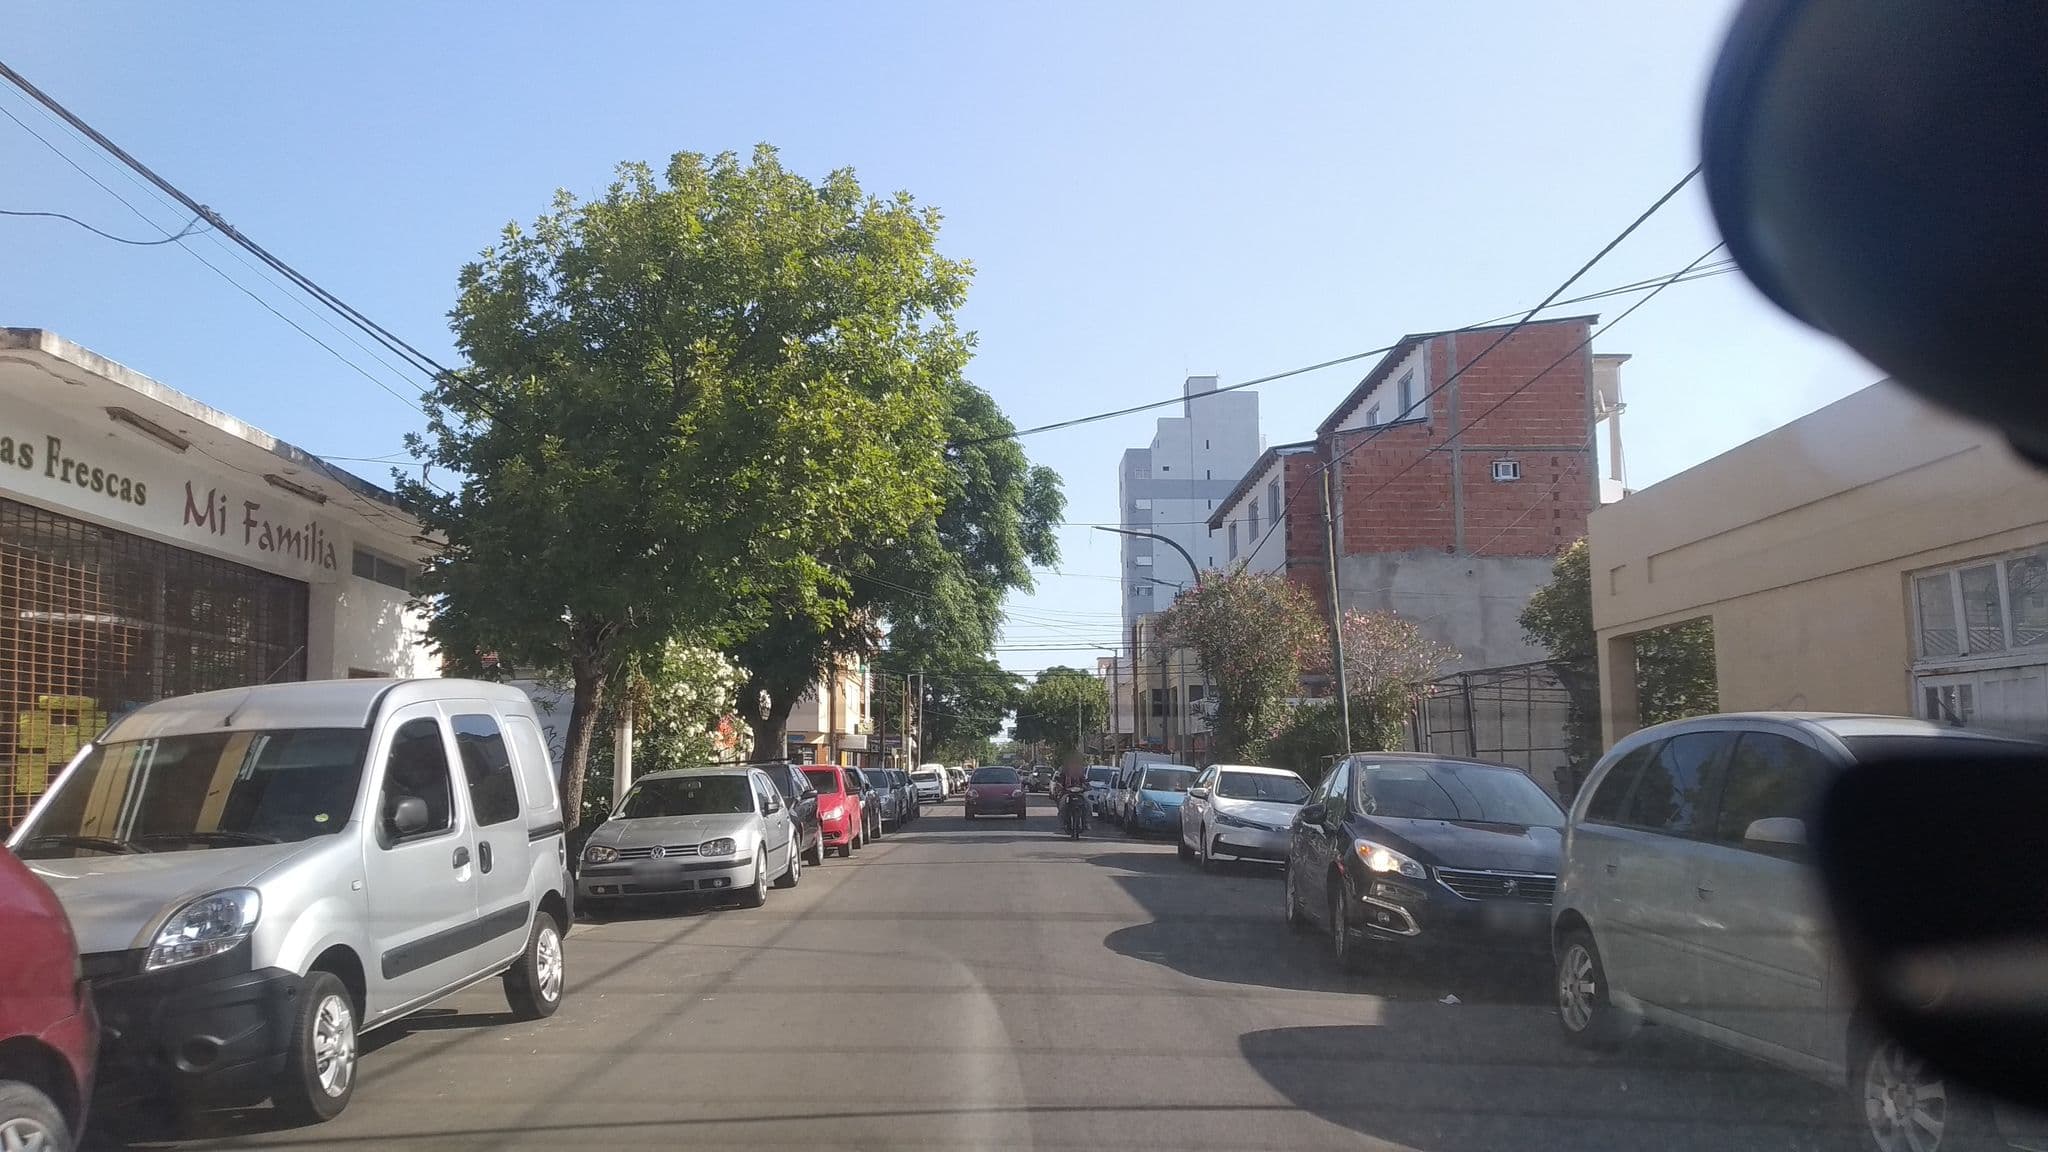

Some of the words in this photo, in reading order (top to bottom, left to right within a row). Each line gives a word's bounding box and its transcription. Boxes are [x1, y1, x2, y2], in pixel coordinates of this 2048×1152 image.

[44, 434, 147, 506] Frescas
[183, 480, 228, 537] Mi
[242, 499, 337, 571] Familia
